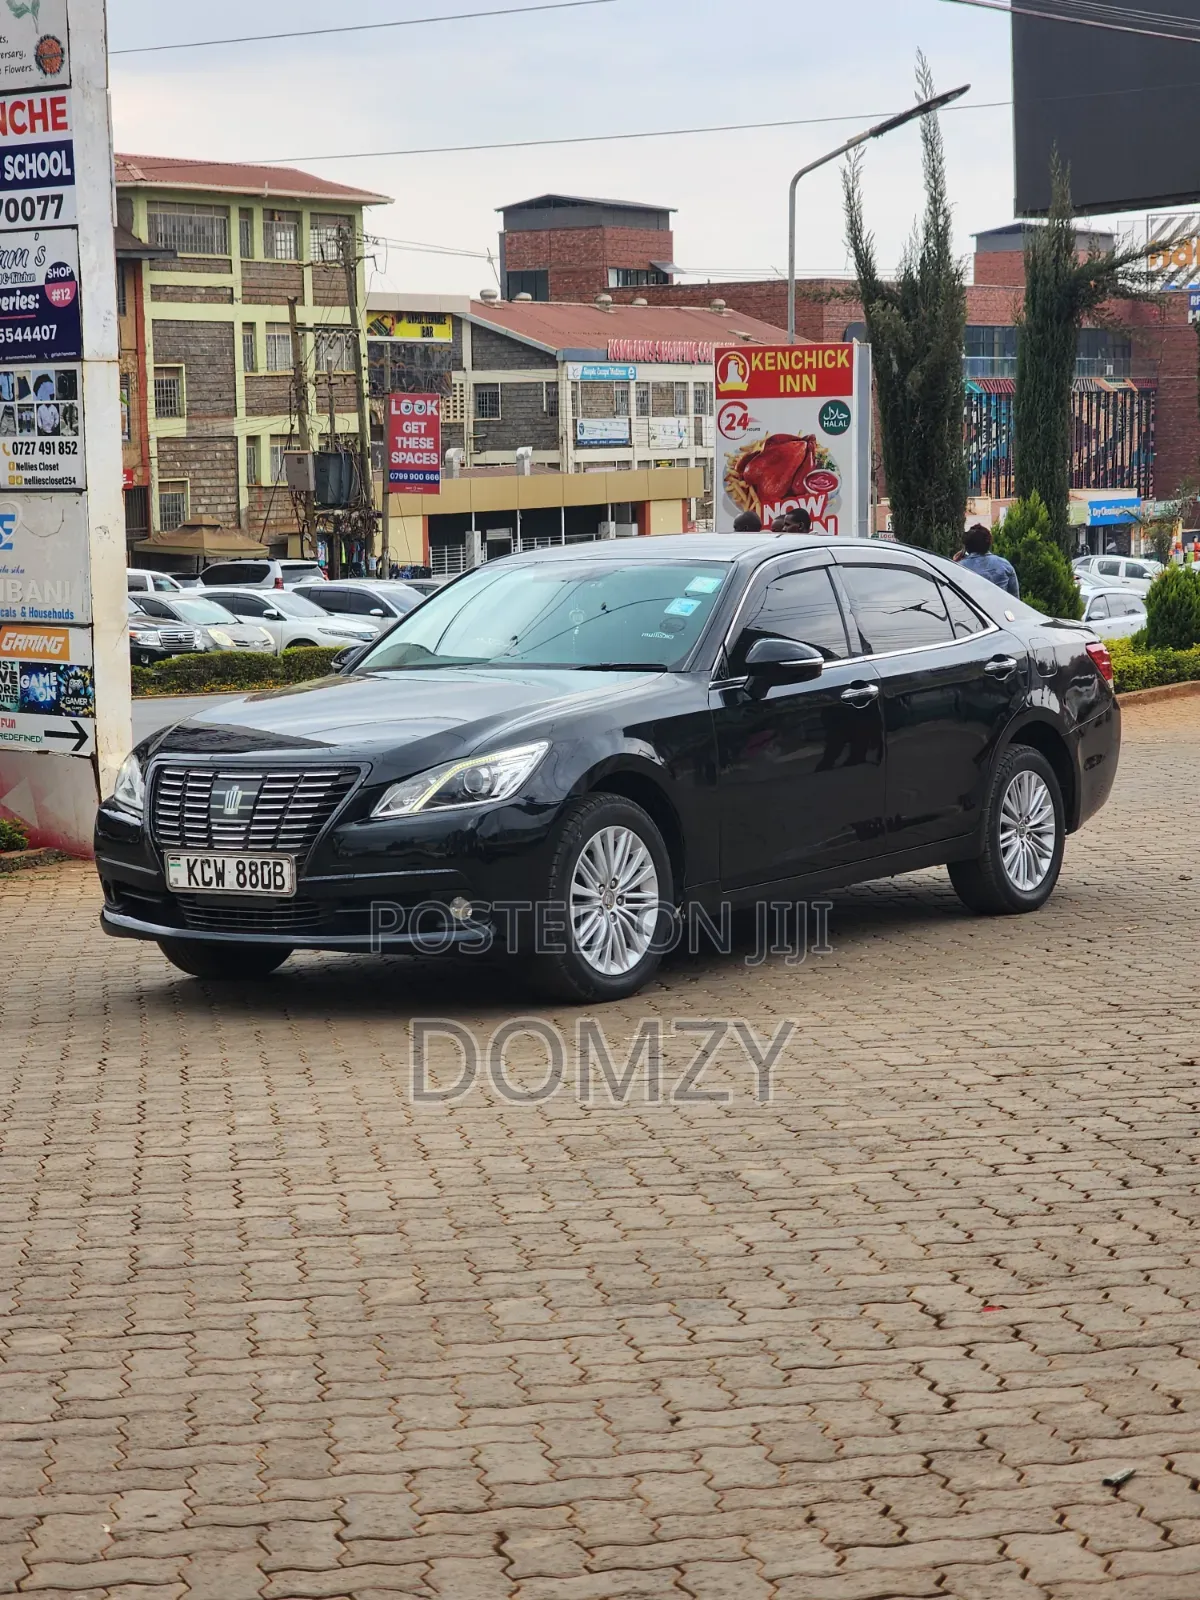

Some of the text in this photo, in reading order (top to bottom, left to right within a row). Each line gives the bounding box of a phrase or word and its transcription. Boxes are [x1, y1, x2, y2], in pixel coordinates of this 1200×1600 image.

[0, 50, 26, 60] ersary,
[4, 149, 71, 181] SCHOOL
[47, 266, 72, 279] SHOP
[0, 289, 40, 311] eries:
[51, 287, 71, 302] #12
[606, 338, 656, 362] KOMRADES
[656, 340, 697, 365] SHOPPING
[751, 349, 850, 371] KENCHICK
[779, 374, 817, 393] INN
[391, 399, 439, 416] LOOK
[402, 421, 427, 434] GET
[724, 413, 749, 431] 24
[823, 420, 848, 429] HALAL
[12, 441, 78, 456] 0727 491 852
[395, 436, 434, 449] THESE
[391, 451, 439, 465] SPACES
[16, 462, 60, 471] Nellies Closet
[24, 476, 77, 485] nelliescloset254
[390, 472, 440, 481] 0799 900 666
[0, 578, 71, 605] BANI
[21, 606, 26, 617] &
[29, 607, 75, 619] Households
[1, 632, 65, 654] GAMING
[0, 661, 15, 671] ST
[20, 671, 58, 689] GAME
[38, 686, 57, 702] ON
[65, 696, 88, 706] GAMER
[186, 857, 286, 890] KCW 880B
